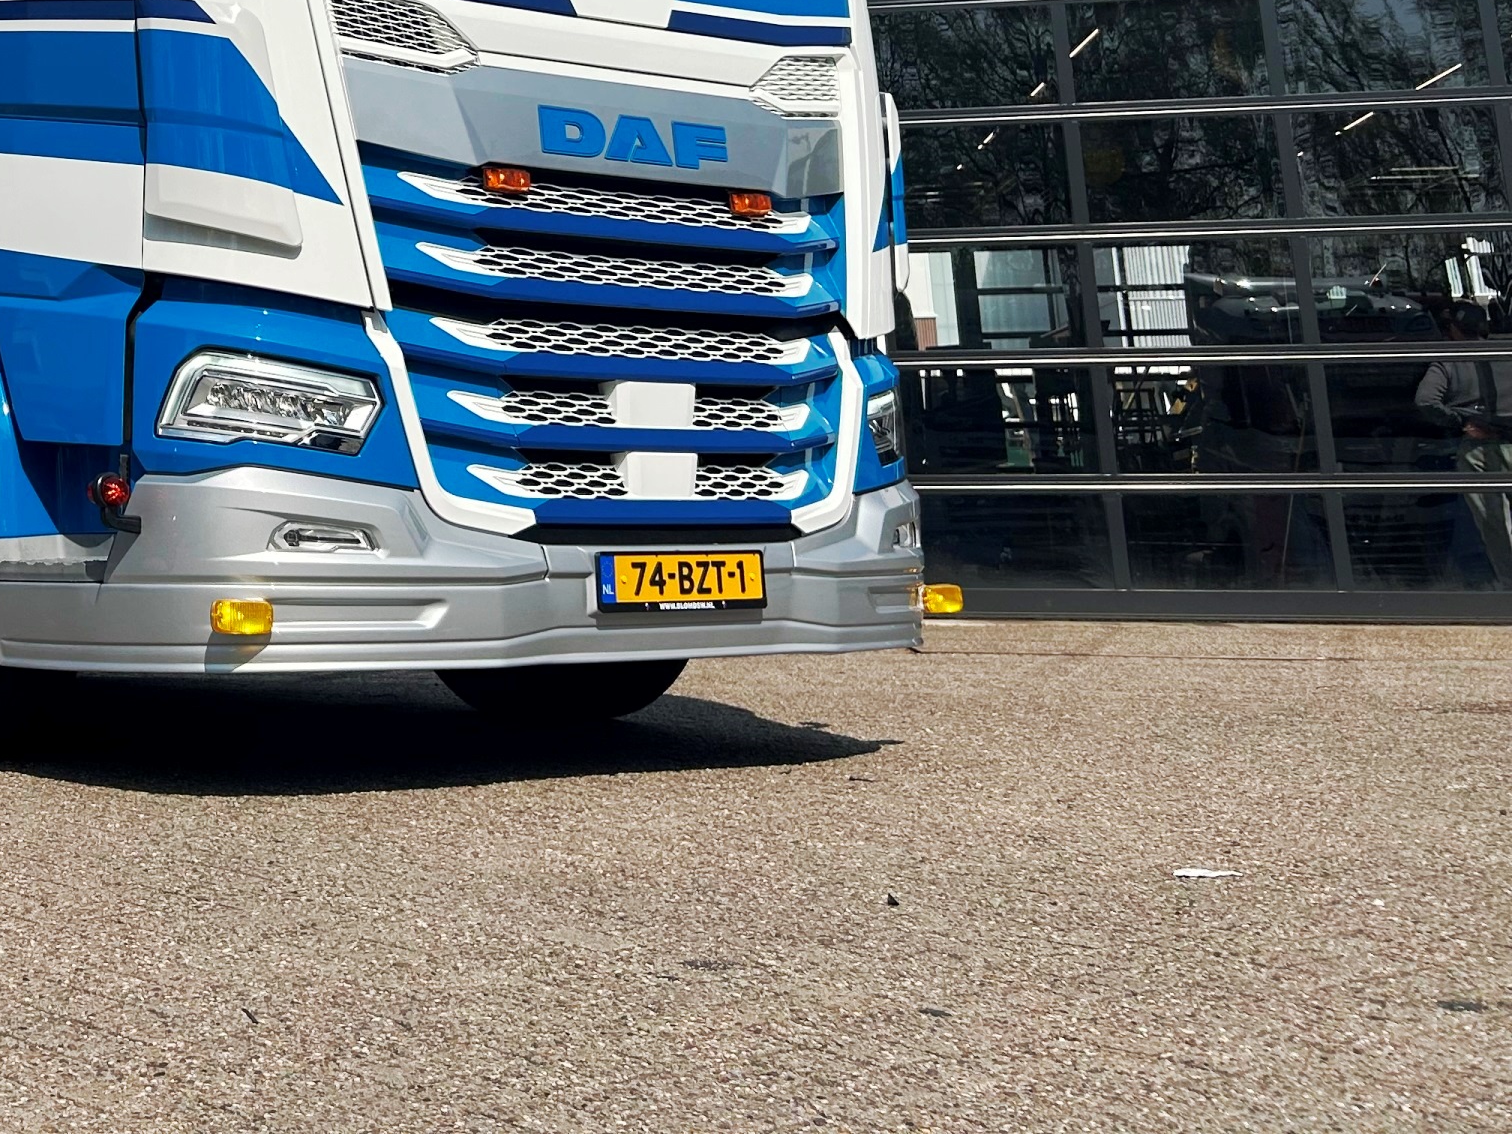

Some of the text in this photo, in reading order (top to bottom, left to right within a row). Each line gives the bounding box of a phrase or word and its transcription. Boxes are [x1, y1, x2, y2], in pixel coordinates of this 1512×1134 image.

[537, 104, 728, 170] DAF
[602, 584, 614, 595] NL
[630, 560, 746, 596] 74-BZT-1
